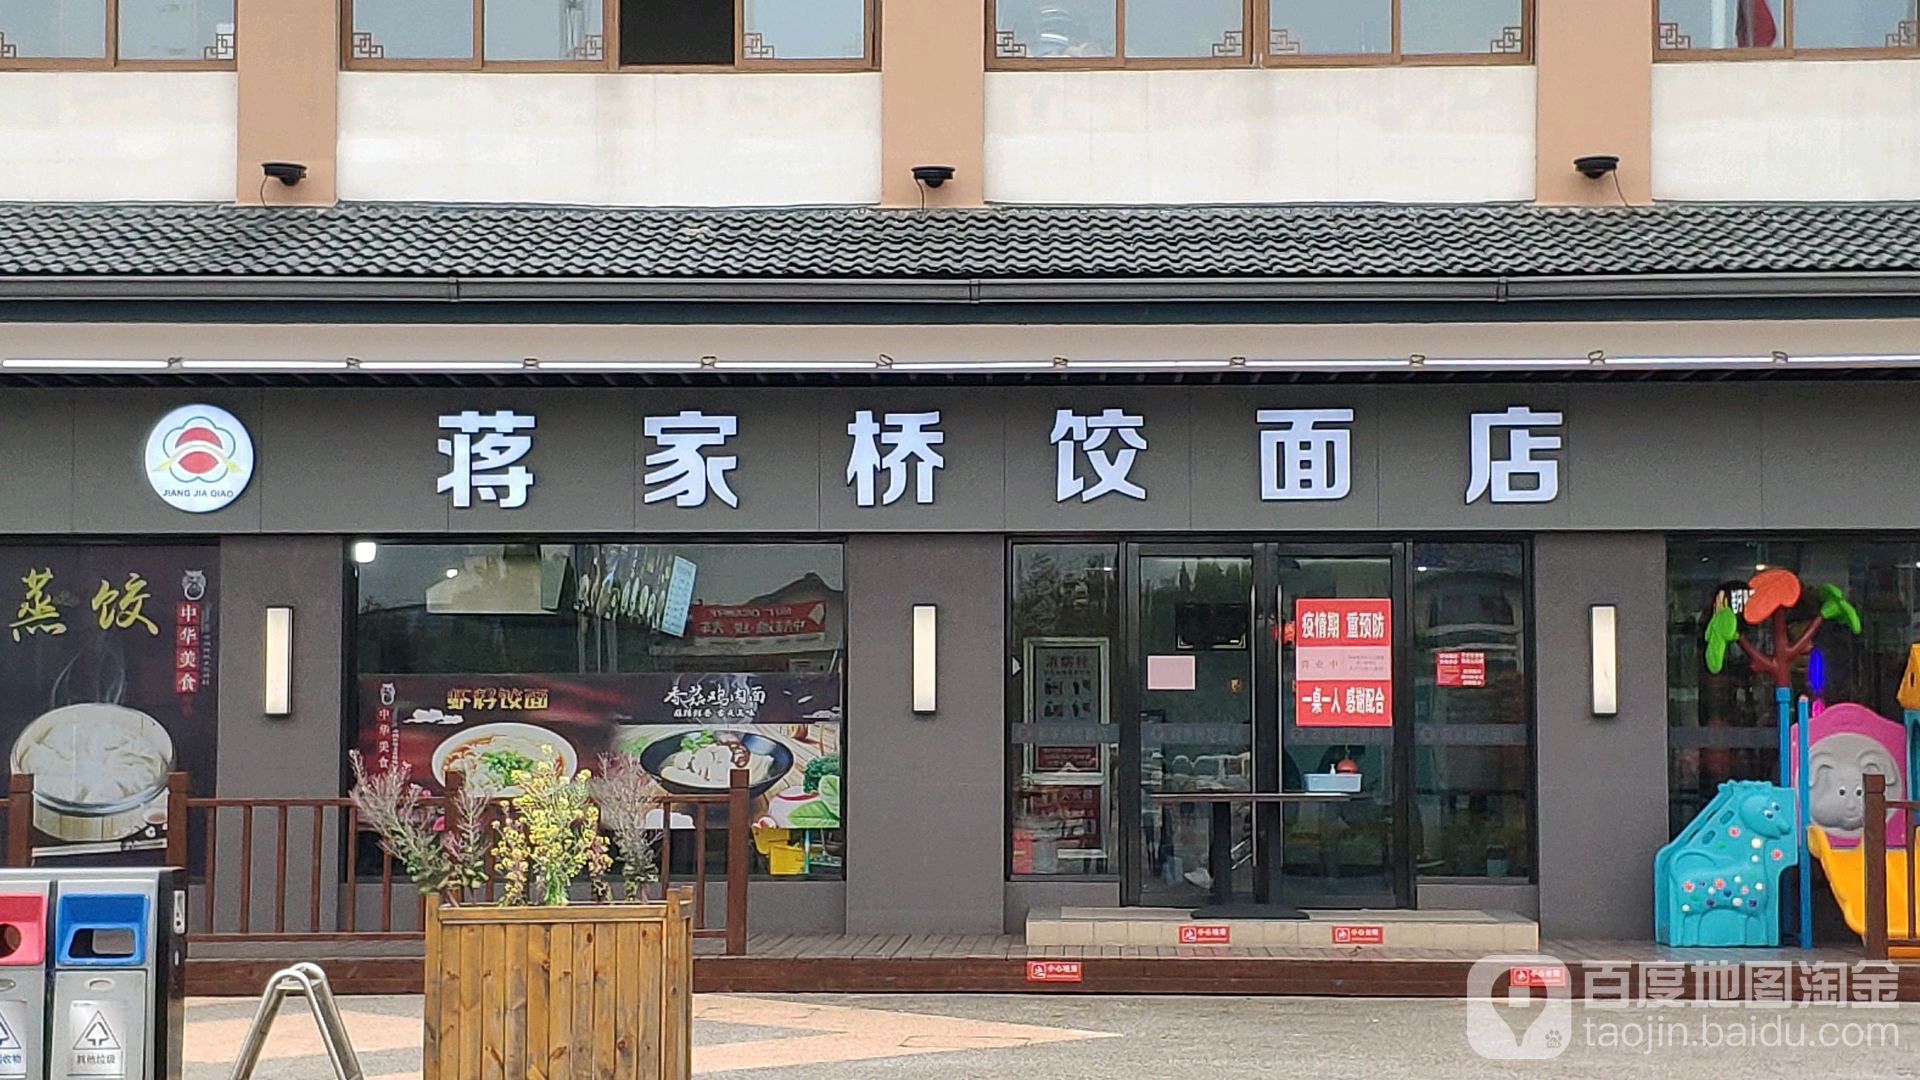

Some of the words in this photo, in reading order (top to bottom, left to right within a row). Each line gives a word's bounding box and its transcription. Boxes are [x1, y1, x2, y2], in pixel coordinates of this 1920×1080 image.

[437, 407, 1563, 507] 蒋家桥饺面店
[211, 490, 234, 498] QIAO
[9, 567, 160, 642] 蒸饺
[1302, 611, 1340, 639] 疫情期
[1346, 611, 1385, 639] 重预防
[179, 604, 198, 691] 中华美食
[663, 684, 766, 706] 香菇鸡肉面
[1302, 686, 1341, 714] 一桌一人
[1345, 686, 1385, 714] 感谢配合
[0, 1054, 22, 1064] 收物
[76, 1054, 116, 1064] 其他垃圾
